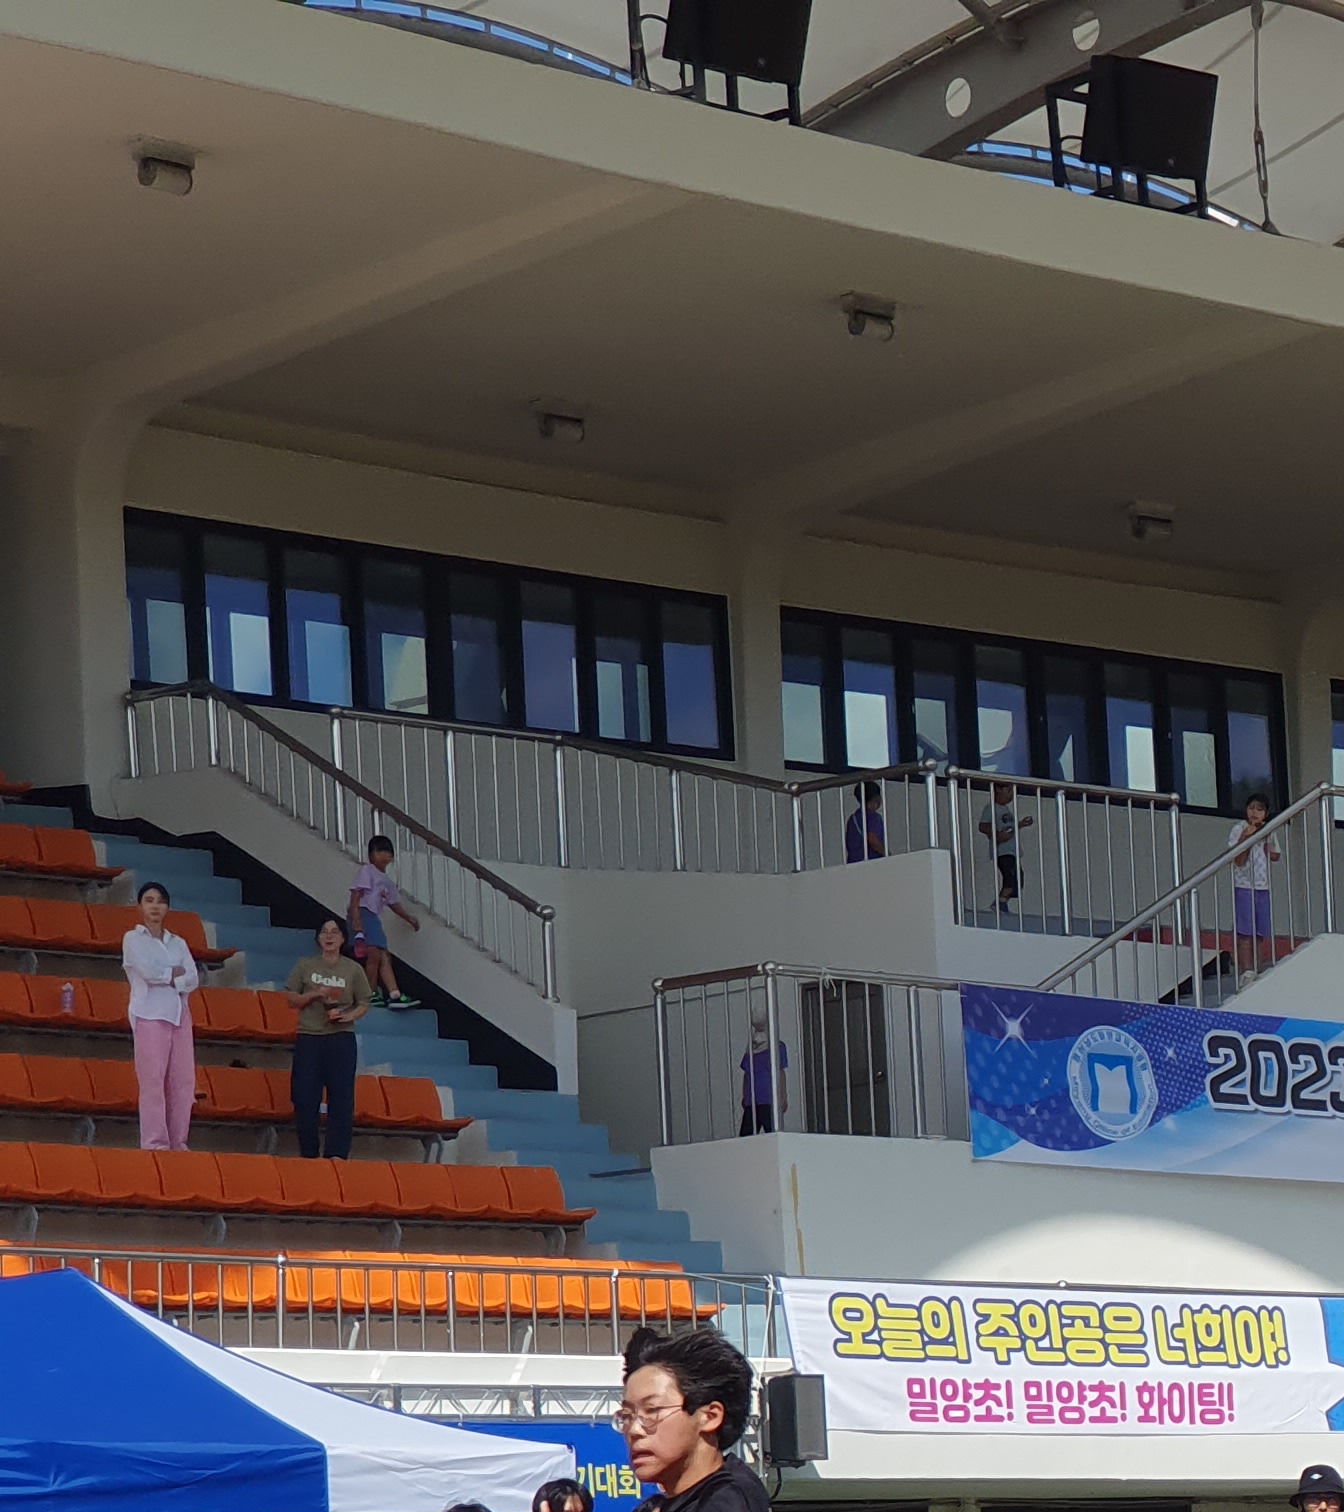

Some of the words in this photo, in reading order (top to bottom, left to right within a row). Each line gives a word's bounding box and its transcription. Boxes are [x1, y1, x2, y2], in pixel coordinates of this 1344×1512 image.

[829, 1291, 972, 1364] 오늘의
[973, 1298, 1151, 1367] 주인공은
[1151, 1303, 1291, 1369] 너희야!
[906, 1377, 1014, 1423] 밀양초!
[1023, 1379, 1128, 1425] 밀양초!
[1135, 1380, 1236, 1426] 화이팅!
